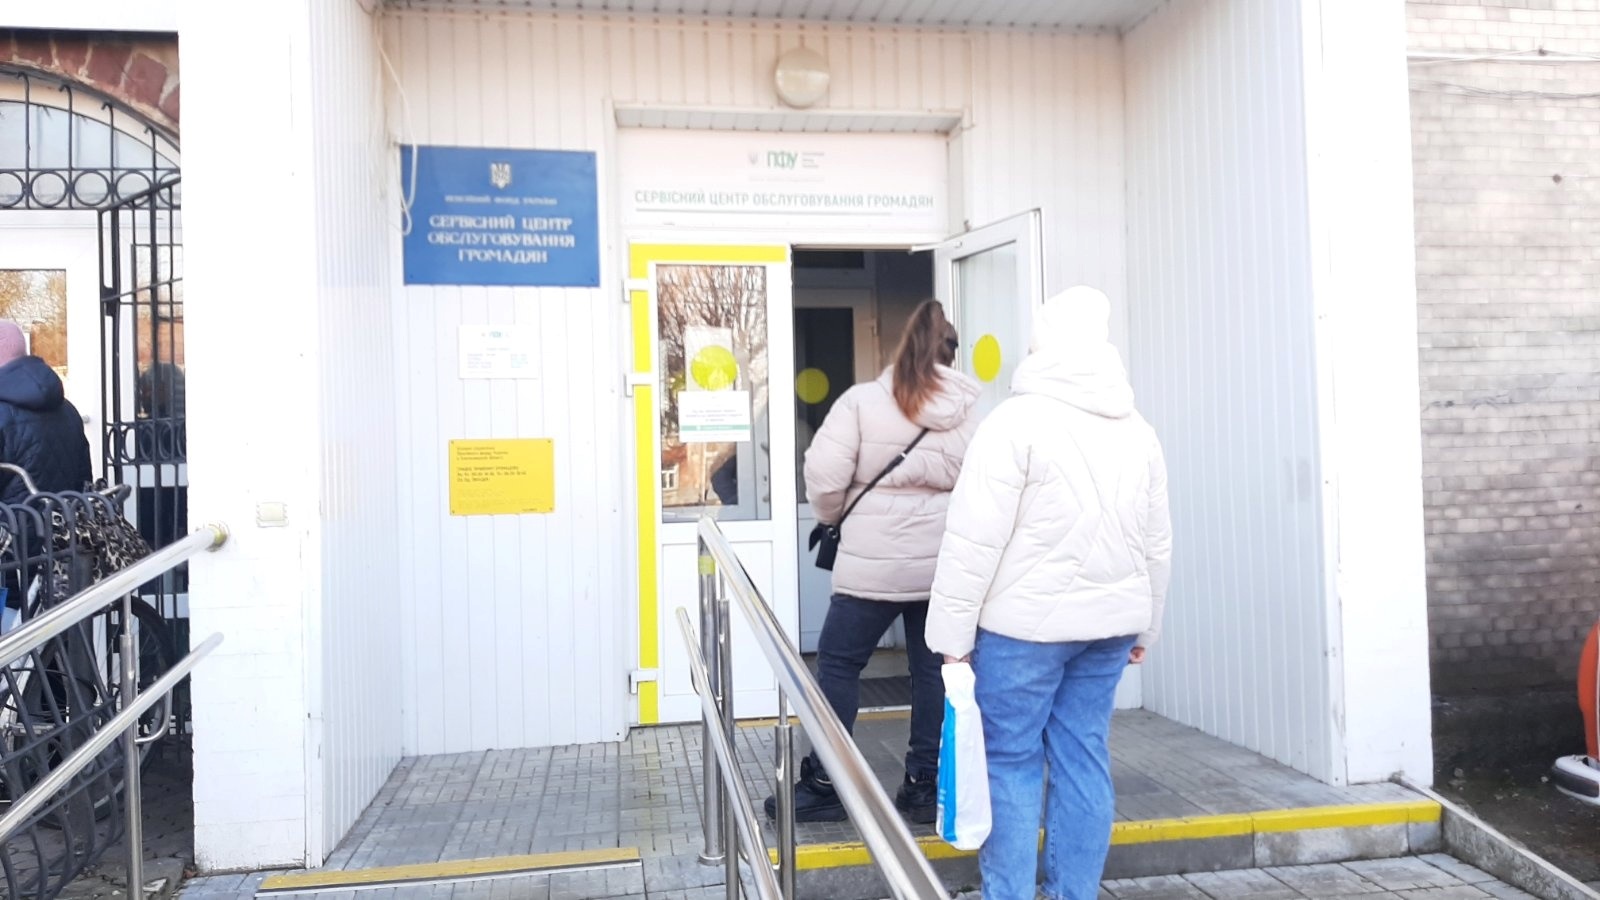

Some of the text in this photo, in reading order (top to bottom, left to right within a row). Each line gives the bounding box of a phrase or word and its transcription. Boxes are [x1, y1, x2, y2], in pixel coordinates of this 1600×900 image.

[767, 150, 798, 169] ПФУ
[635, 188, 934, 208] СЕРВІСНИЙ ЦЕНТР ОБСЛУГОВУВАННЯ ГРОМАДЯН
[429, 214, 573, 231] СЕРВІСНИЙ ЦЕНТР
[427, 231, 575, 248] ОБСЛУГОВУВАННЯ
[458, 248, 548, 264] ГРОМАДЯН
